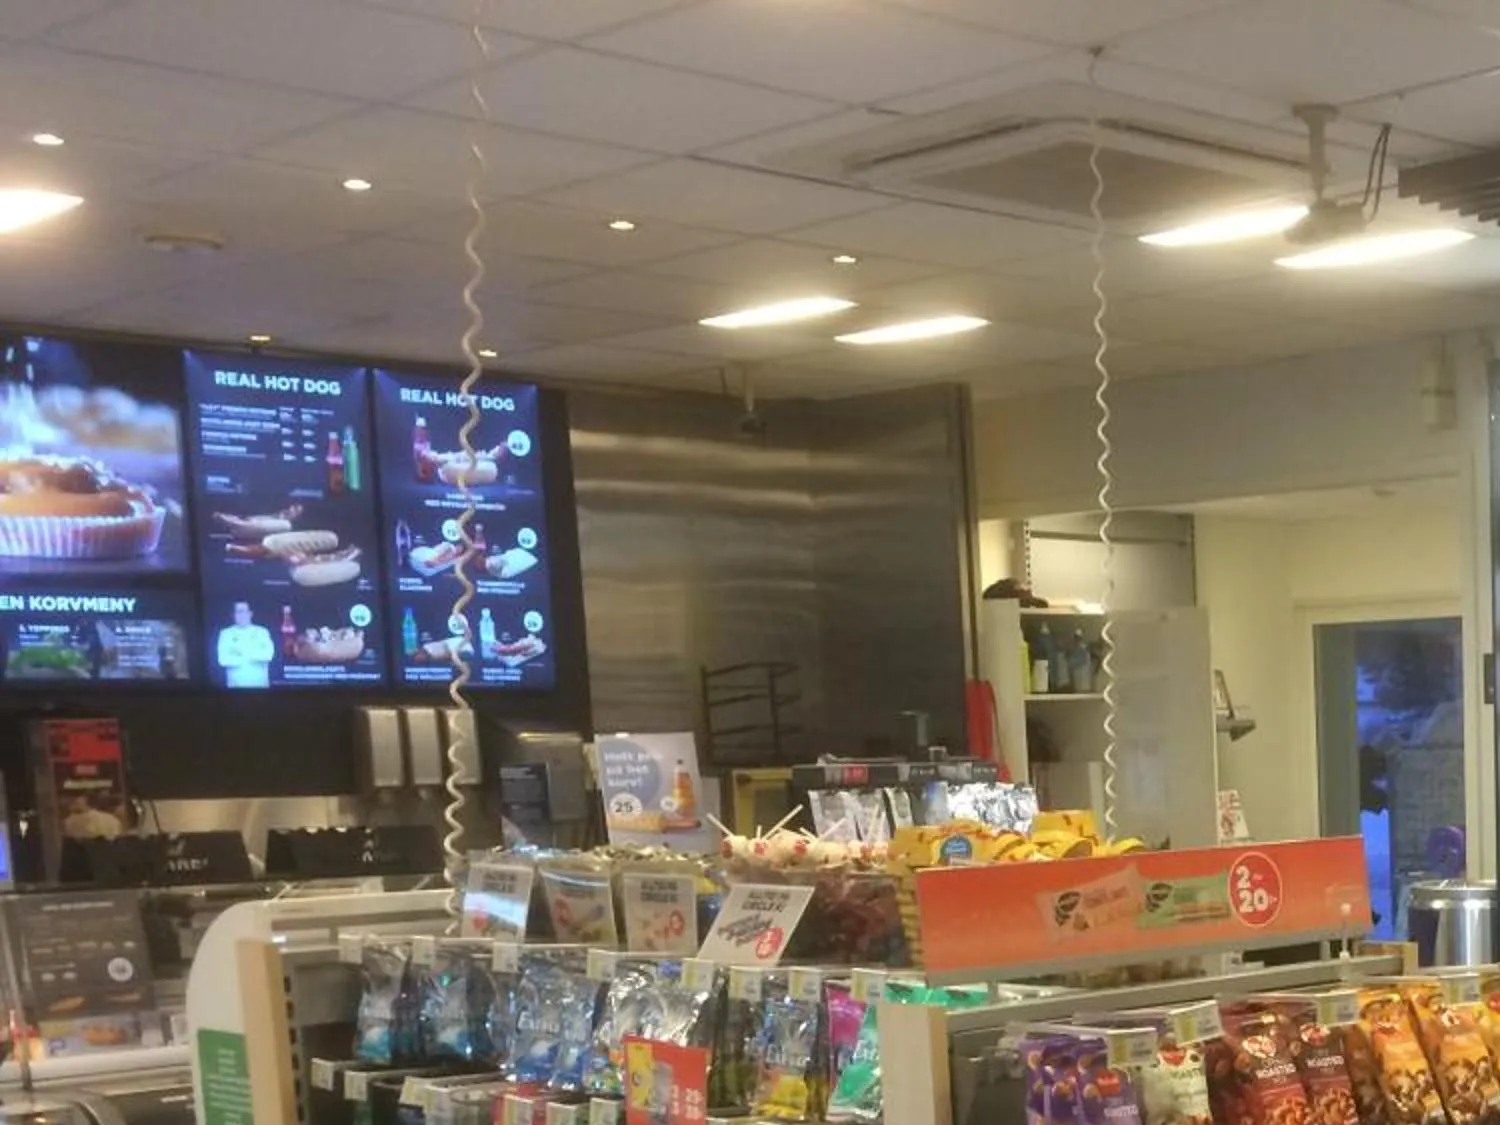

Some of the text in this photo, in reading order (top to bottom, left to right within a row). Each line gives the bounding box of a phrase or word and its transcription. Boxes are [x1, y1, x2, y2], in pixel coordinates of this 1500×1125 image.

[214, 370, 341, 396] REAL HOT DOG
[400, 387, 442, 404] REAL
[481, 396, 515, 411] DOG
[29, 596, 136, 613] KORVMENY
